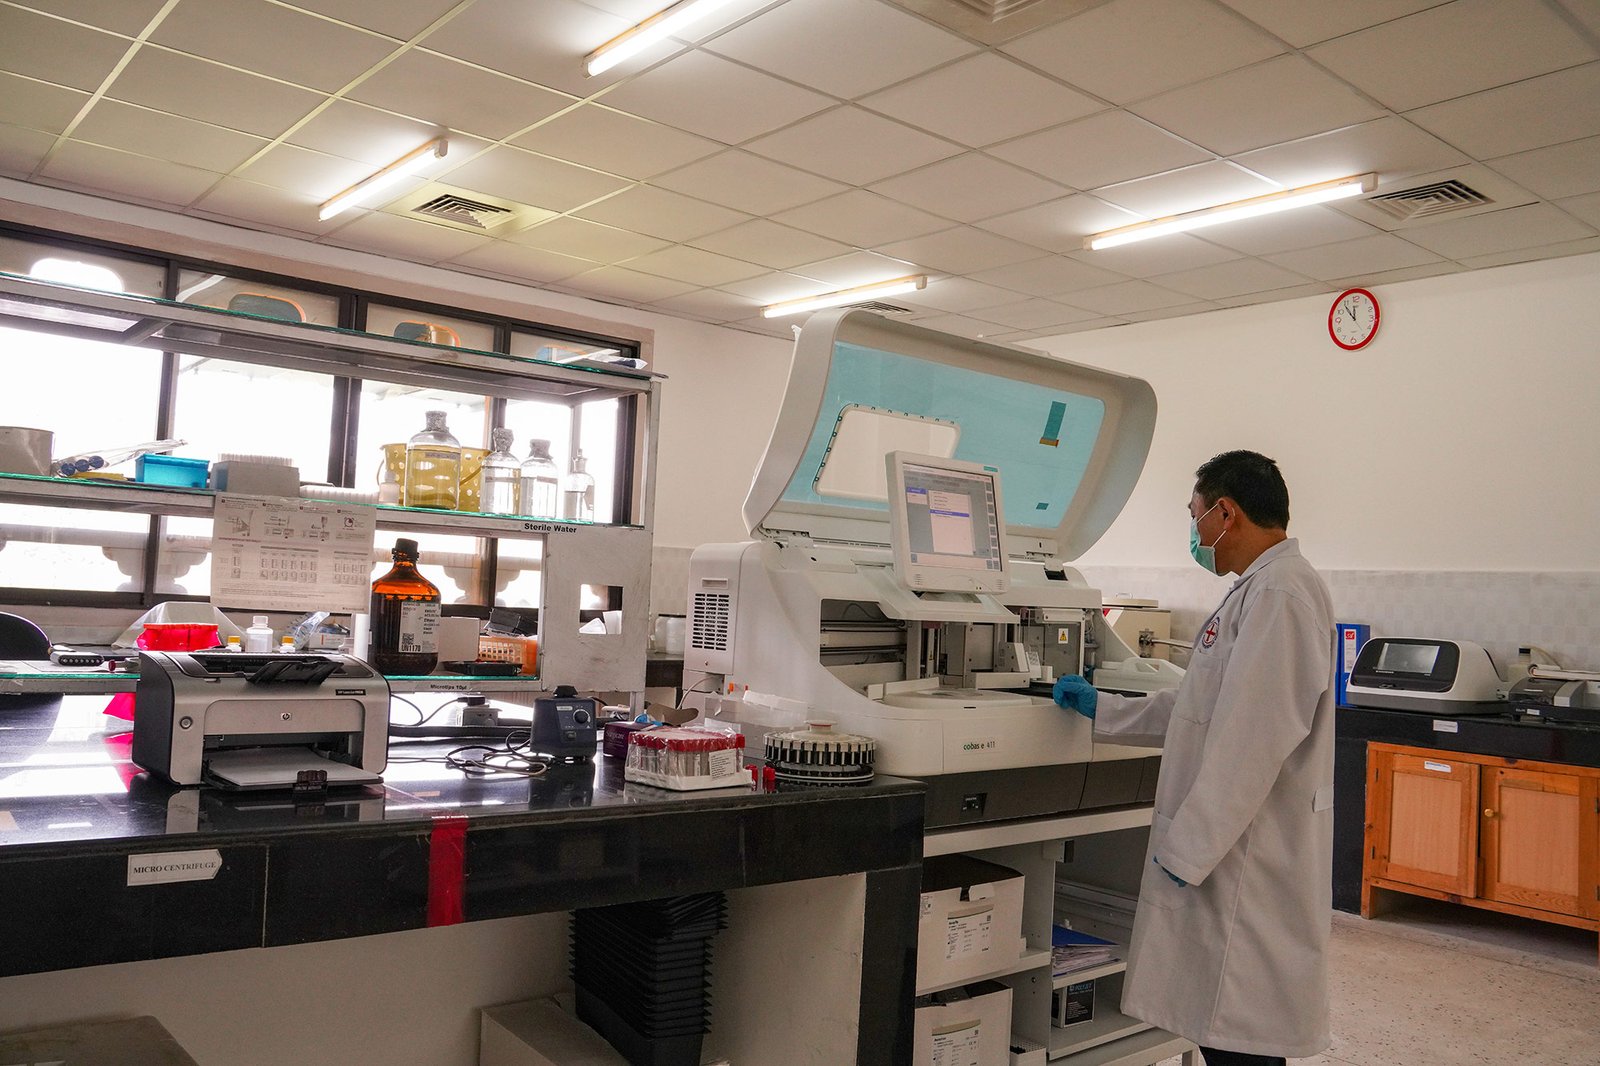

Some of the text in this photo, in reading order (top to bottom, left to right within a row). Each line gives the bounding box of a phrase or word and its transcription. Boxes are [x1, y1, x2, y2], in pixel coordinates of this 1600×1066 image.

[1352, 295, 1360, 303] 12
[1350, 336, 1357, 344] 6
[524, 523, 577, 533] Sterile Water
[963, 742, 979, 750] cobas
[133, 862, 216, 874] MICRO CENTRIFUGE
